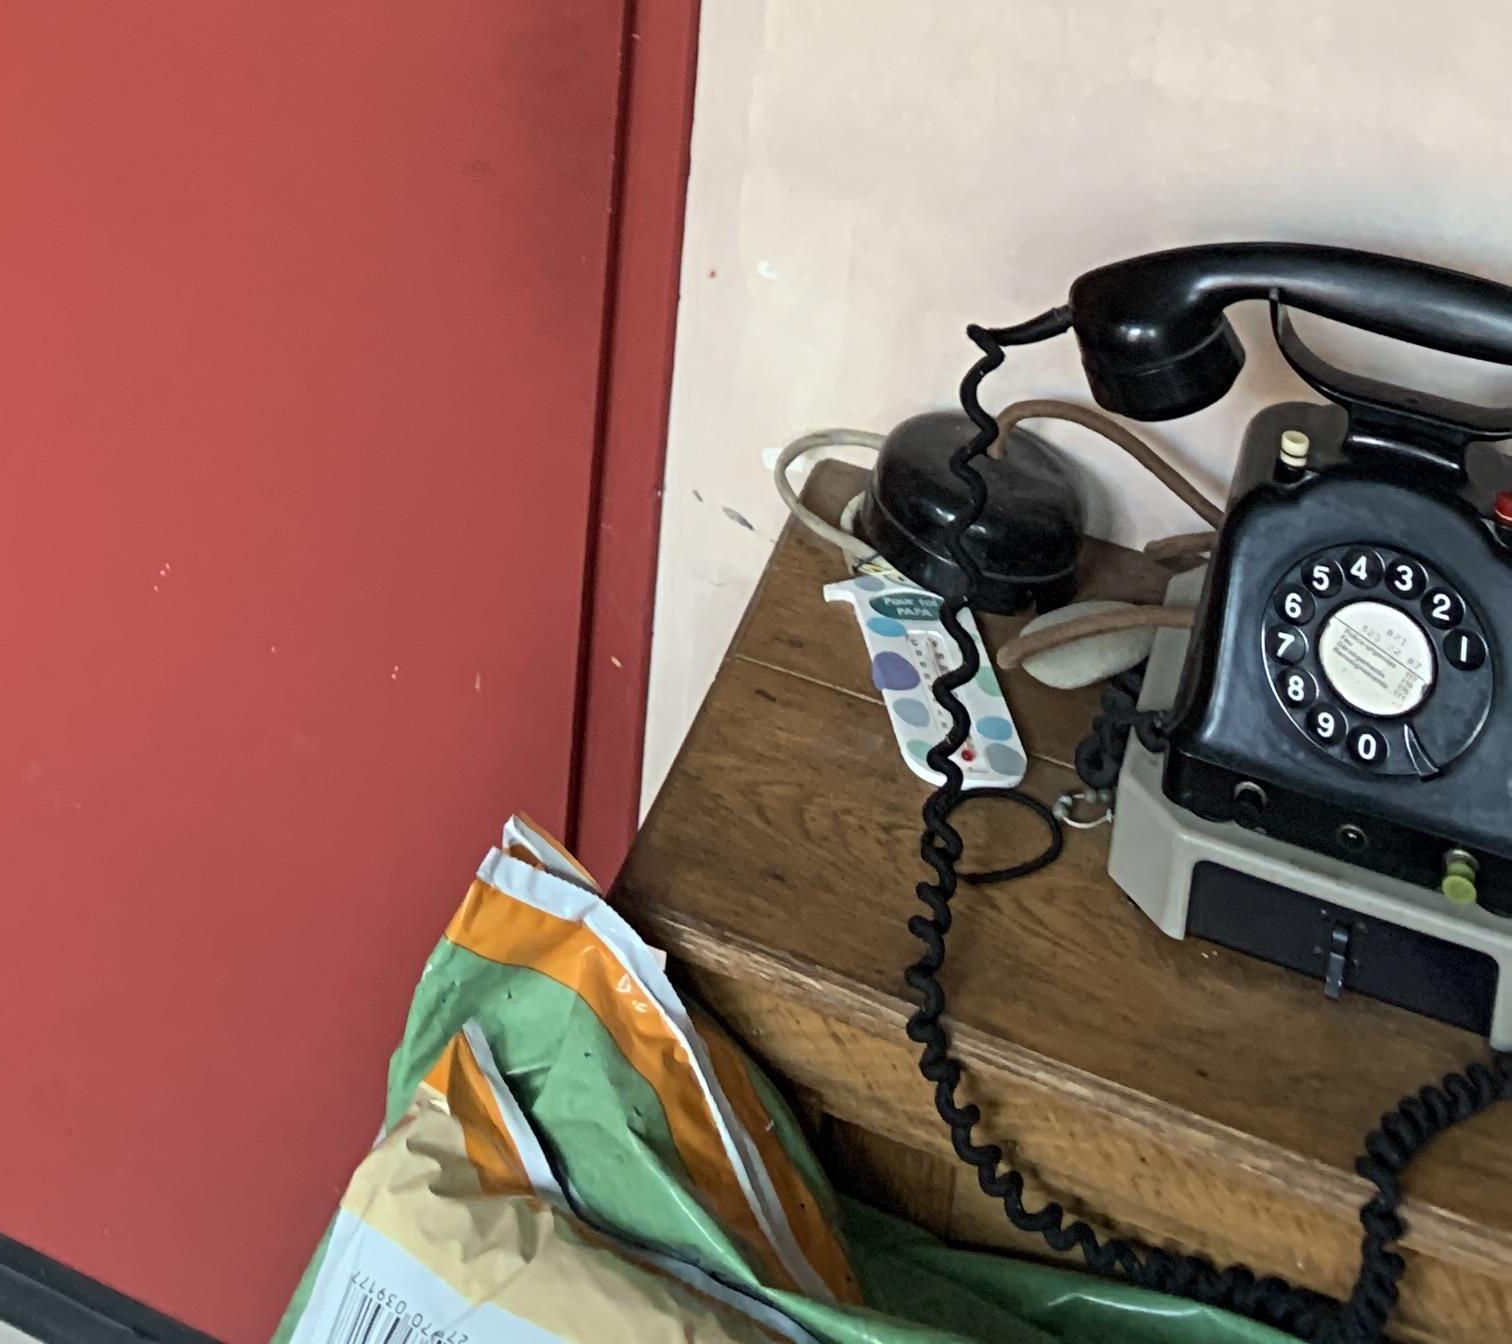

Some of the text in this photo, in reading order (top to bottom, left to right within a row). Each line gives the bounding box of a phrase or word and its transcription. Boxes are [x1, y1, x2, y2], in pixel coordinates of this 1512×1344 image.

[1312, 565, 1331, 592] 5
[1350, 555, 1369, 581] 4
[1394, 565, 1414, 592] 3
[895, 606, 933, 618] PAPA
[1284, 592, 1303, 619] 6
[1432, 593, 1451, 622] 2
[1277, 631, 1296, 658] 7
[1460, 635, 1469, 663] 1
[1287, 675, 1305, 702] 8
[1317, 711, 1336, 739] 9
[1358, 733, 1377, 761] 0
[350, 1269, 408, 1315] 039177
